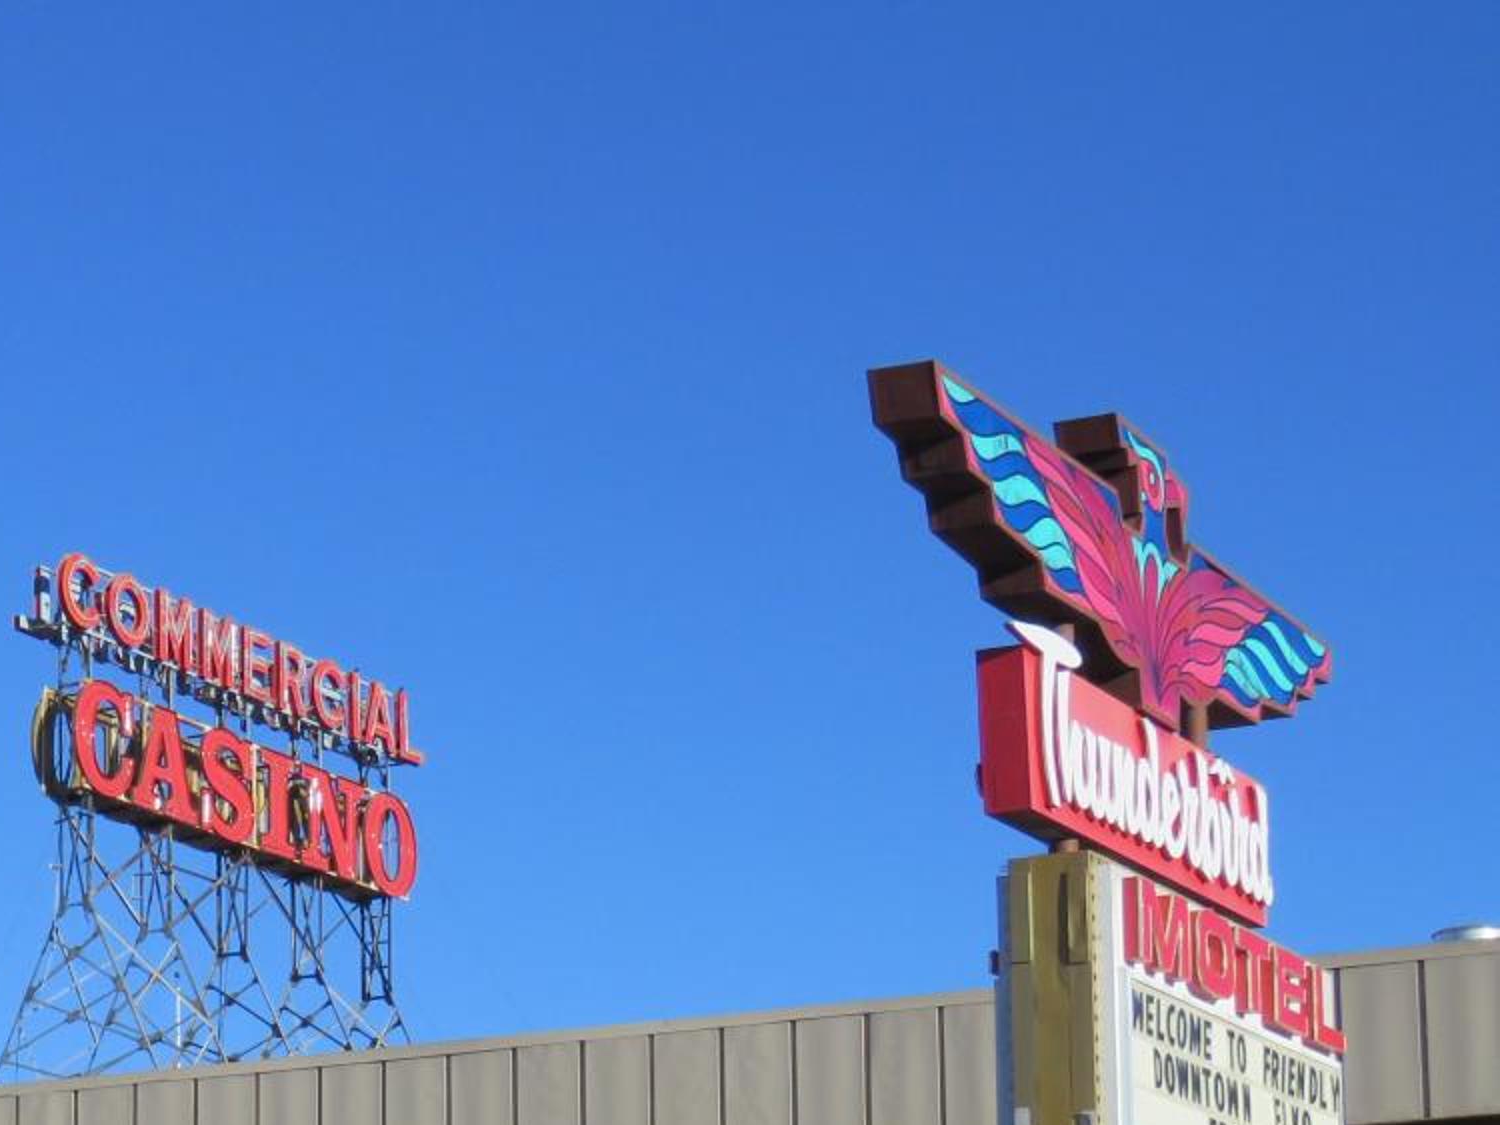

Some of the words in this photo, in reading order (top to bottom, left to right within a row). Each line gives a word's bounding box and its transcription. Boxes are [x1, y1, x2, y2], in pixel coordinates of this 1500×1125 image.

[57, 553, 426, 767] COMMERCIAL
[73, 680, 418, 899] CASINO
[1006, 620, 1274, 906] Thunderbird
[1122, 876, 1347, 1055] MOTEL
[1132, 990, 1212, 1061] WELCOME
[1226, 1029, 1247, 1074] TO
[1263, 1046, 1341, 1114] FRIENDLY
[1153, 1047, 1252, 1124] DOWNTOWN
